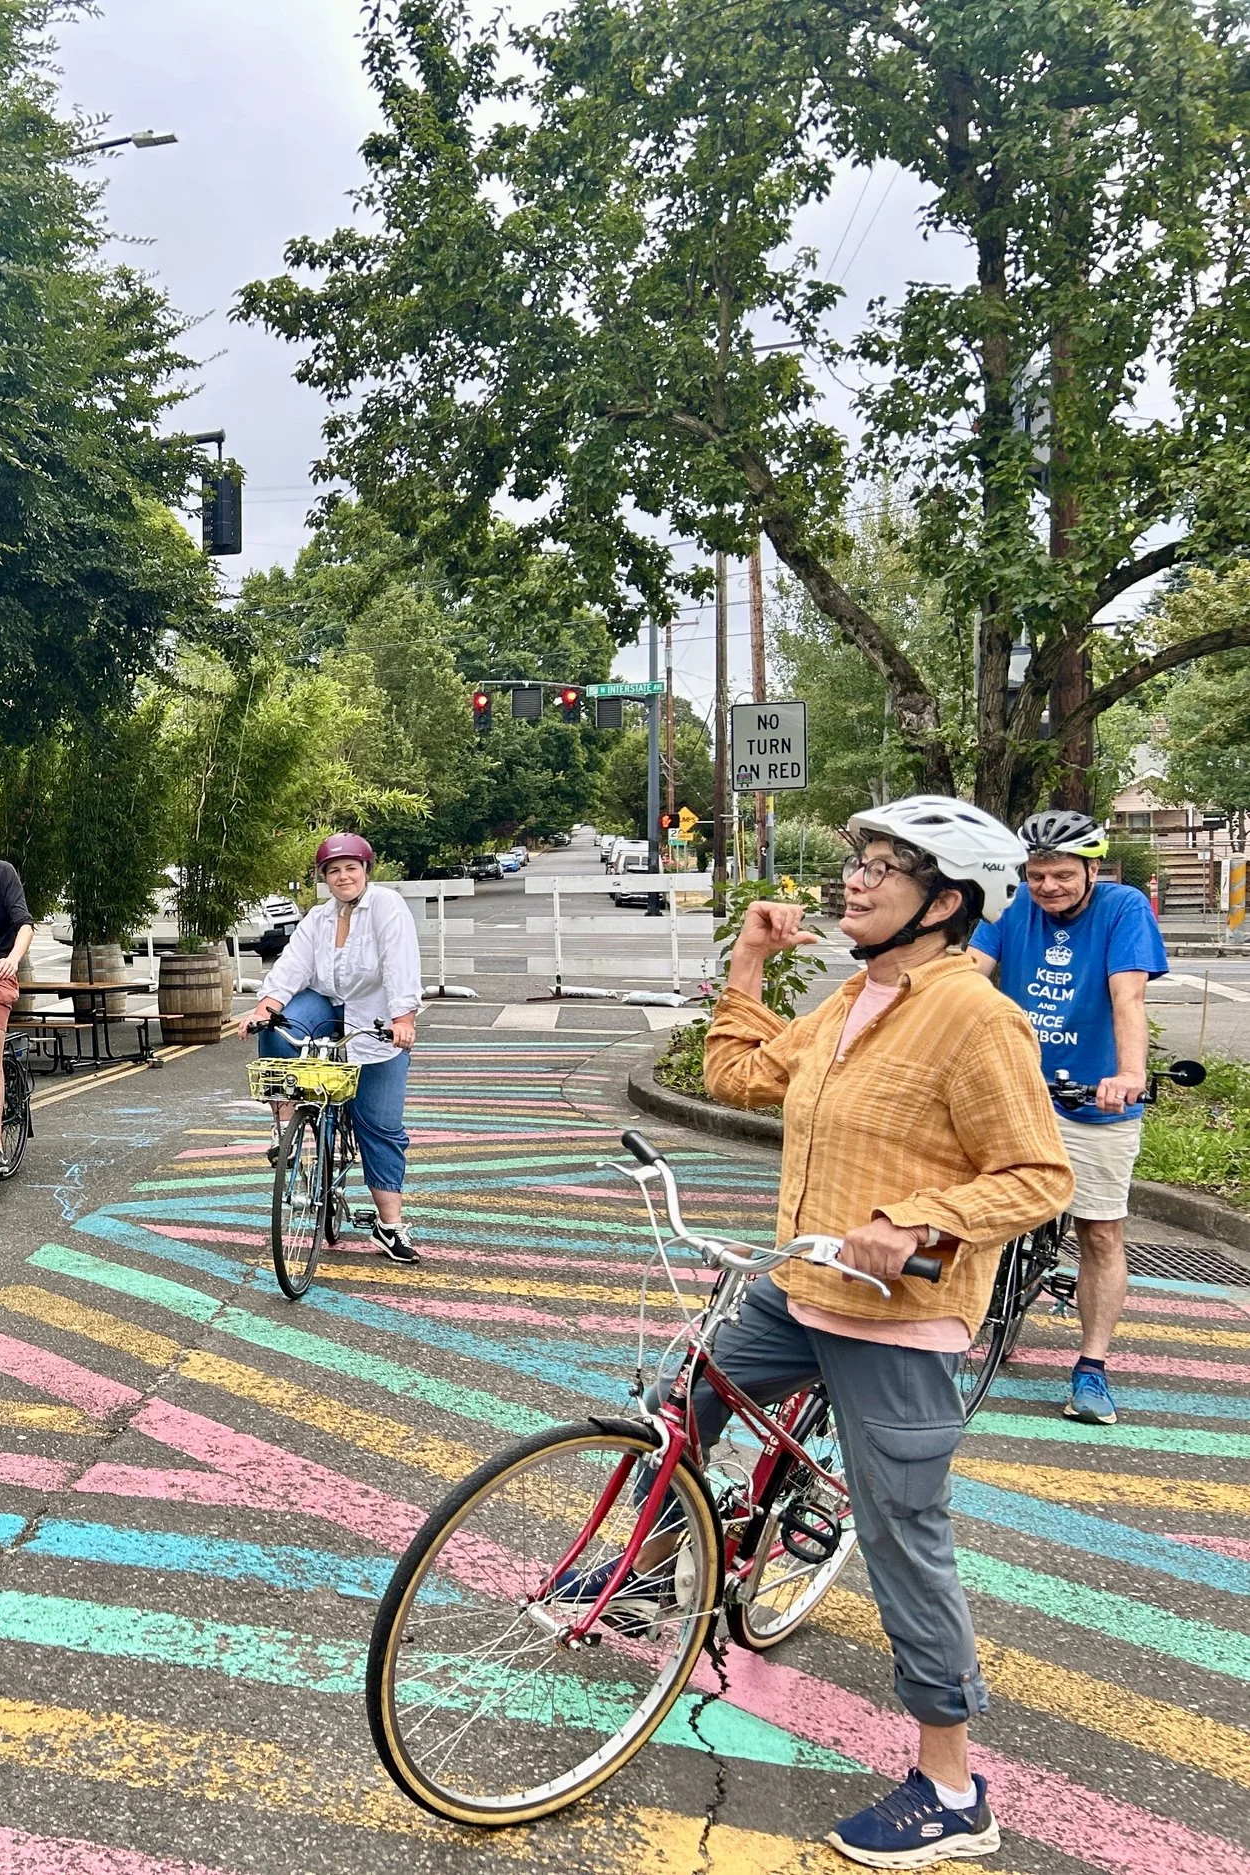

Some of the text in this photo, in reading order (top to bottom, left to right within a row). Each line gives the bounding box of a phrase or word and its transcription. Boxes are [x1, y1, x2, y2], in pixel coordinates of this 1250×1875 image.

[608, 684, 652, 694] INTERSTATE
[757, 714, 779, 730] NO
[747, 738, 791, 755] TURN
[768, 762, 801, 779] RED
[1035, 968, 1073, 985] KEEP
[1027, 983, 1075, 1001] CALM
[1037, 1002, 1057, 1011] AND
